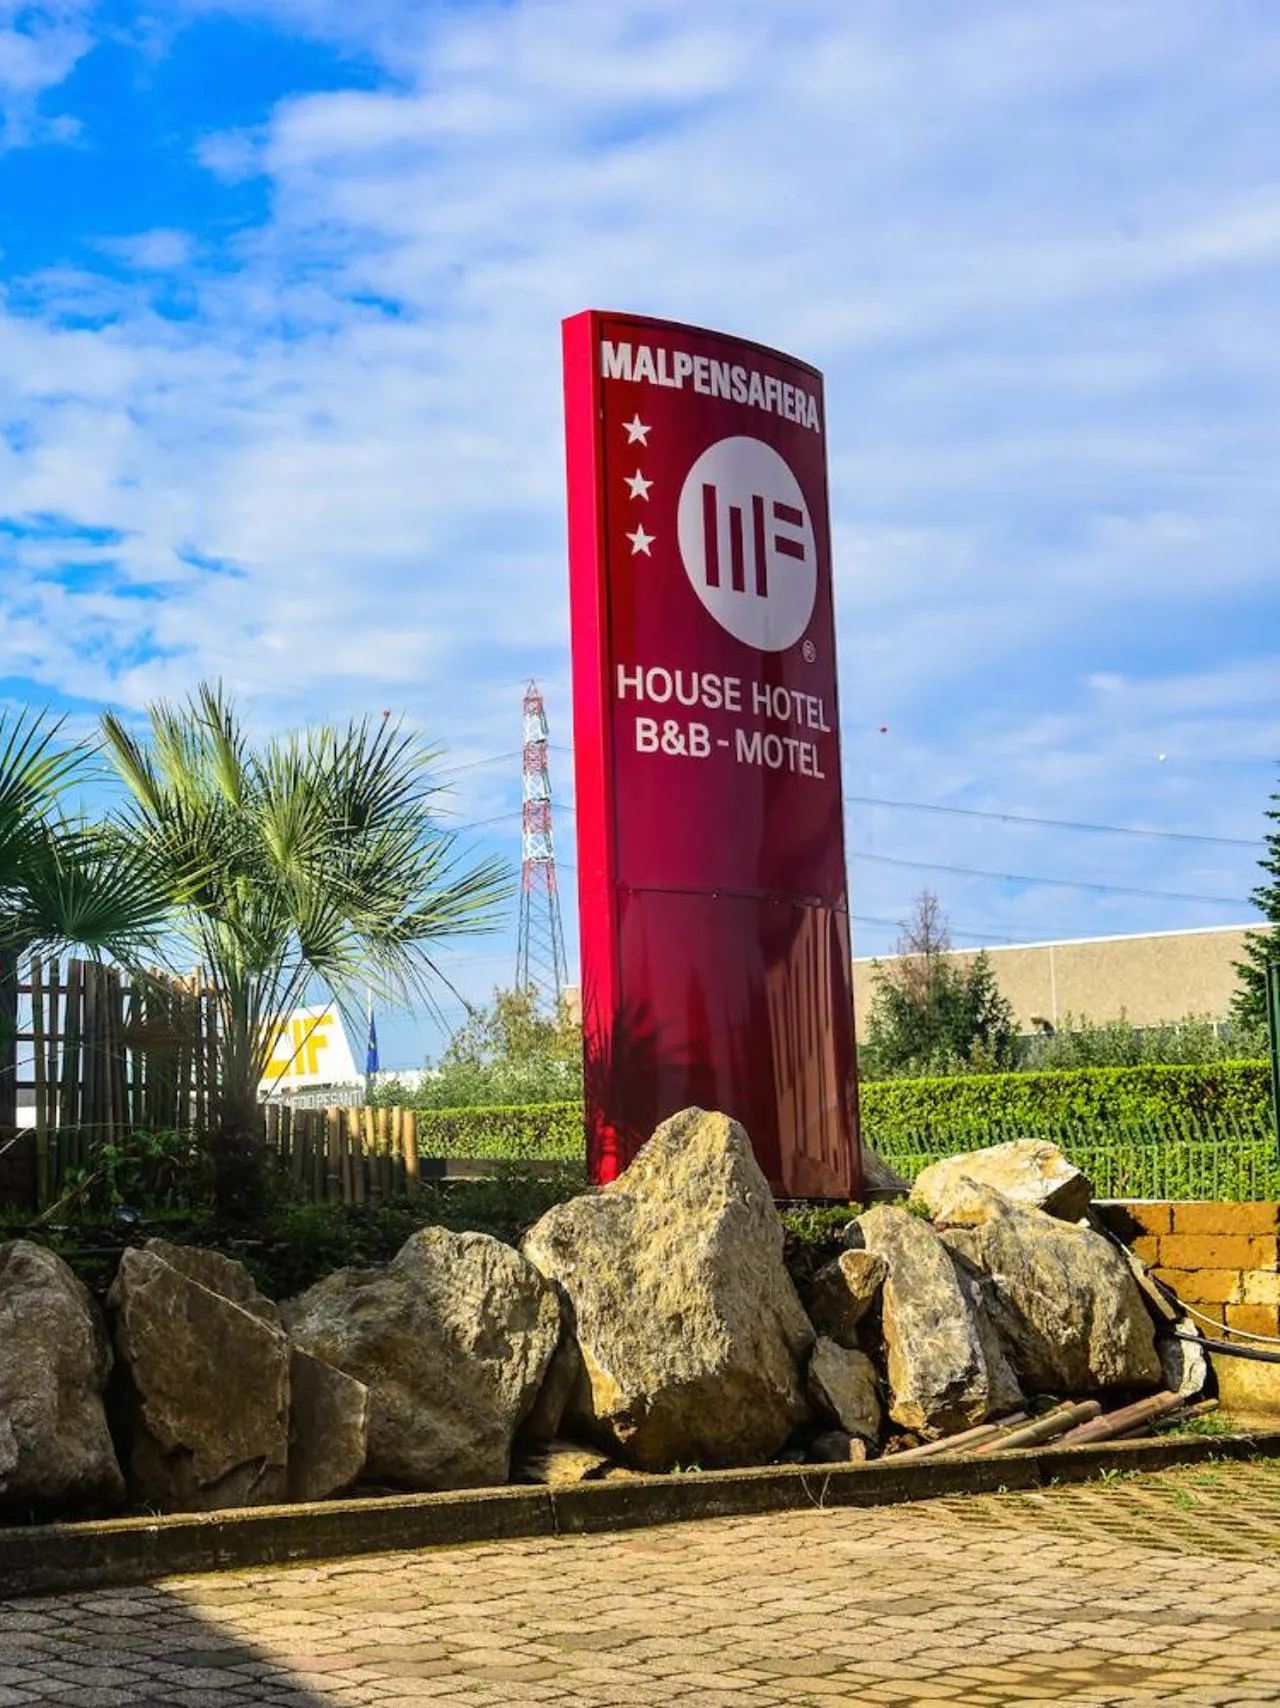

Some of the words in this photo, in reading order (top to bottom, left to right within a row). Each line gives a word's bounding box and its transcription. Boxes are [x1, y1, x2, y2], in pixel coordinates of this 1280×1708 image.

[601, 341, 820, 433] MALPENSAFIERA
[617, 664, 742, 712] HOUSE
[752, 681, 831, 732] HOTEL
[636, 717, 710, 758] B&B
[736, 728, 825, 778] MOTEL
